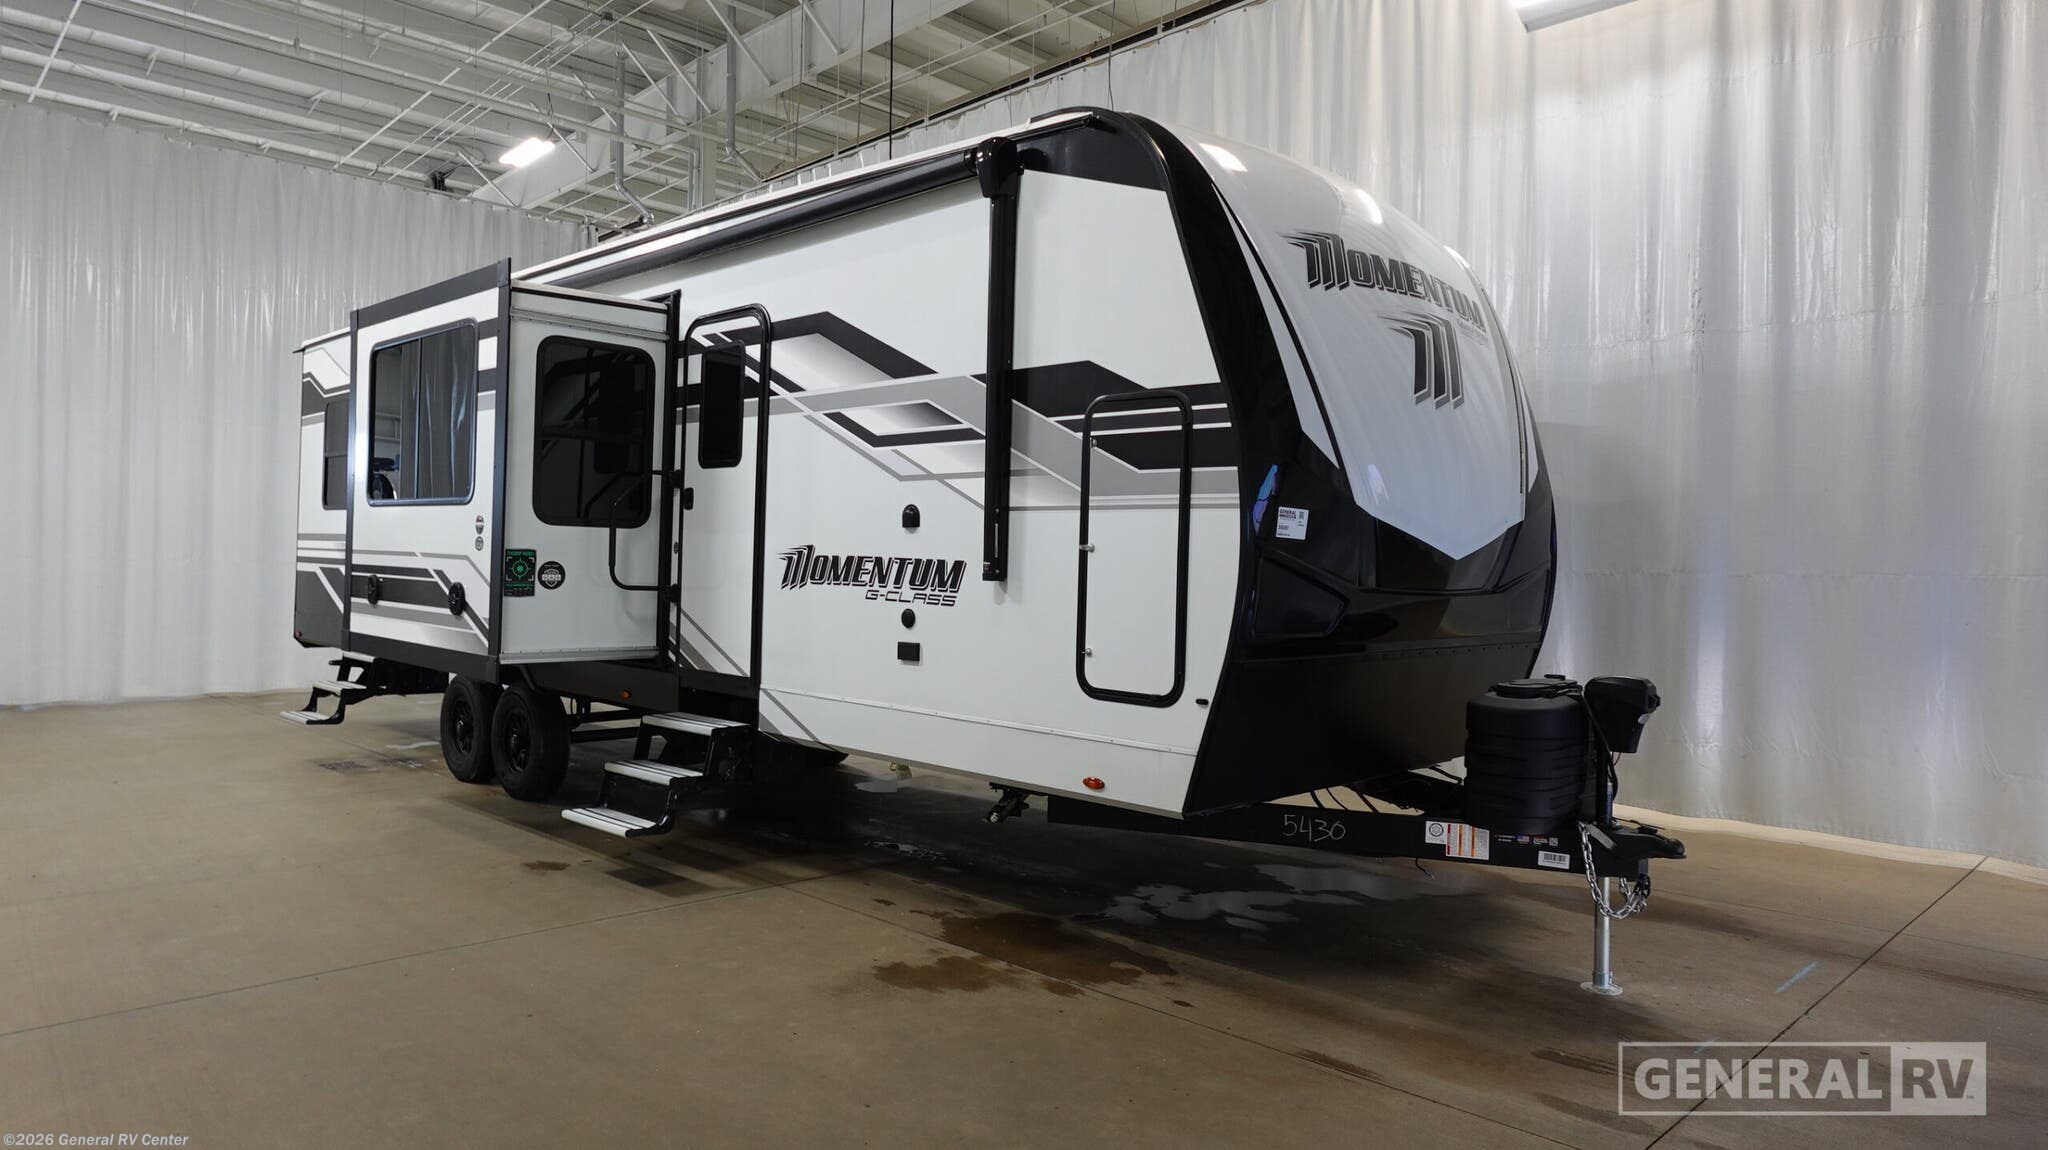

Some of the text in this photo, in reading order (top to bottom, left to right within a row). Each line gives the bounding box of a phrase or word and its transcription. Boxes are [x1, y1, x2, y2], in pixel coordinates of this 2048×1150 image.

[1278, 229, 1487, 332] MOMENTUM
[776, 544, 967, 593] MOMENTUM
[865, 590, 957, 607] G-CLASS
[1282, 814, 1346, 842] 5430
